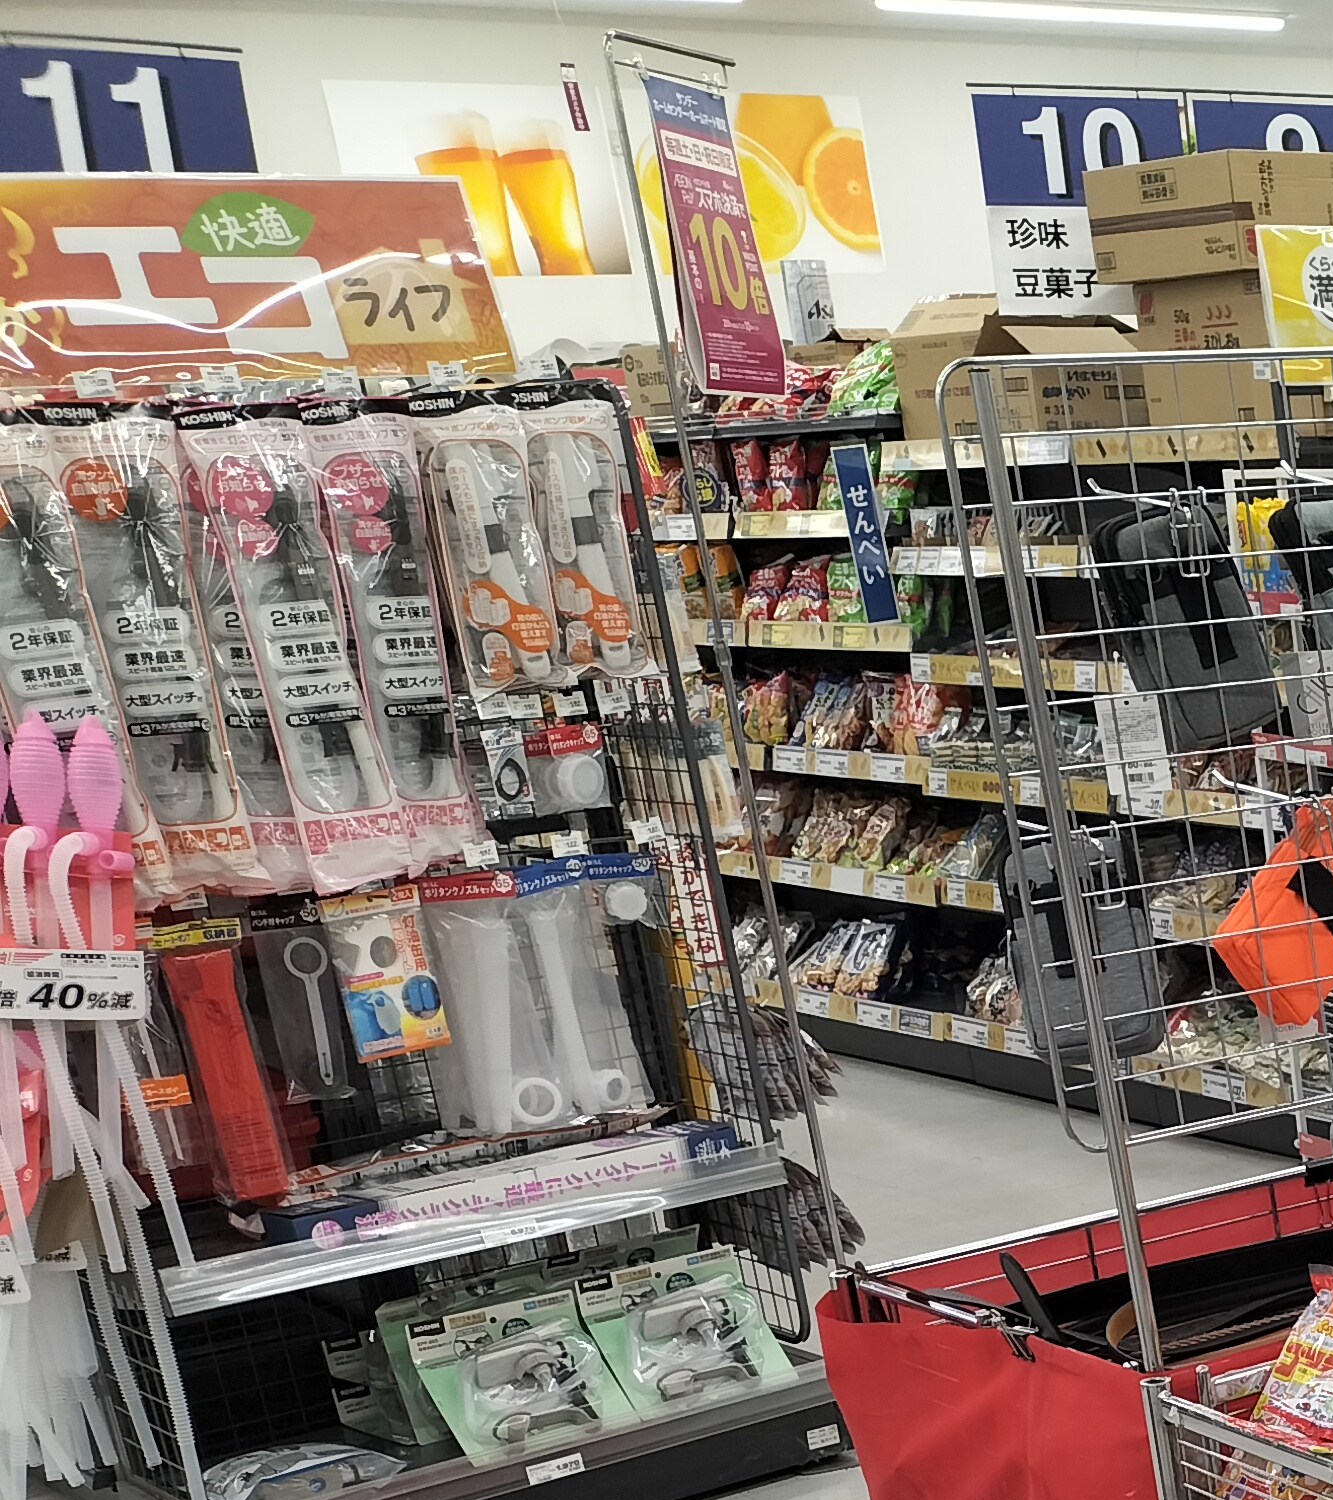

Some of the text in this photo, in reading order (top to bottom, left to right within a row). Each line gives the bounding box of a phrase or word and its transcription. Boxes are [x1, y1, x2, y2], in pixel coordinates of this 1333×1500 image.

[21, 60, 174, 172] 11
[1022, 106, 1140, 194] 10
[201, 202, 300, 251] 快適
[1006, 218, 1069, 249] 珍味
[689, 213, 747, 310] 10
[53, 226, 348, 358] エコ
[1013, 269, 1099, 298] 豆菓子
[343, 278, 451, 331] ライフ
[44, 408, 97, 420] KOSHIN
[301, 402, 350, 420] KOSHIN
[409, 398, 455, 412] KOSHIN
[180, 411, 234, 426] KOSHIN
[847, 484, 888, 586] せんべい
[270, 610, 330, 627] 2年保証
[10, 629, 75, 650] 2年保証
[281, 641, 340, 658] 業界最速
[125, 650, 187, 667] 業界最速
[21, 663, 85, 681] 業界最速
[284, 683, 351, 698] 大型スイッチ
